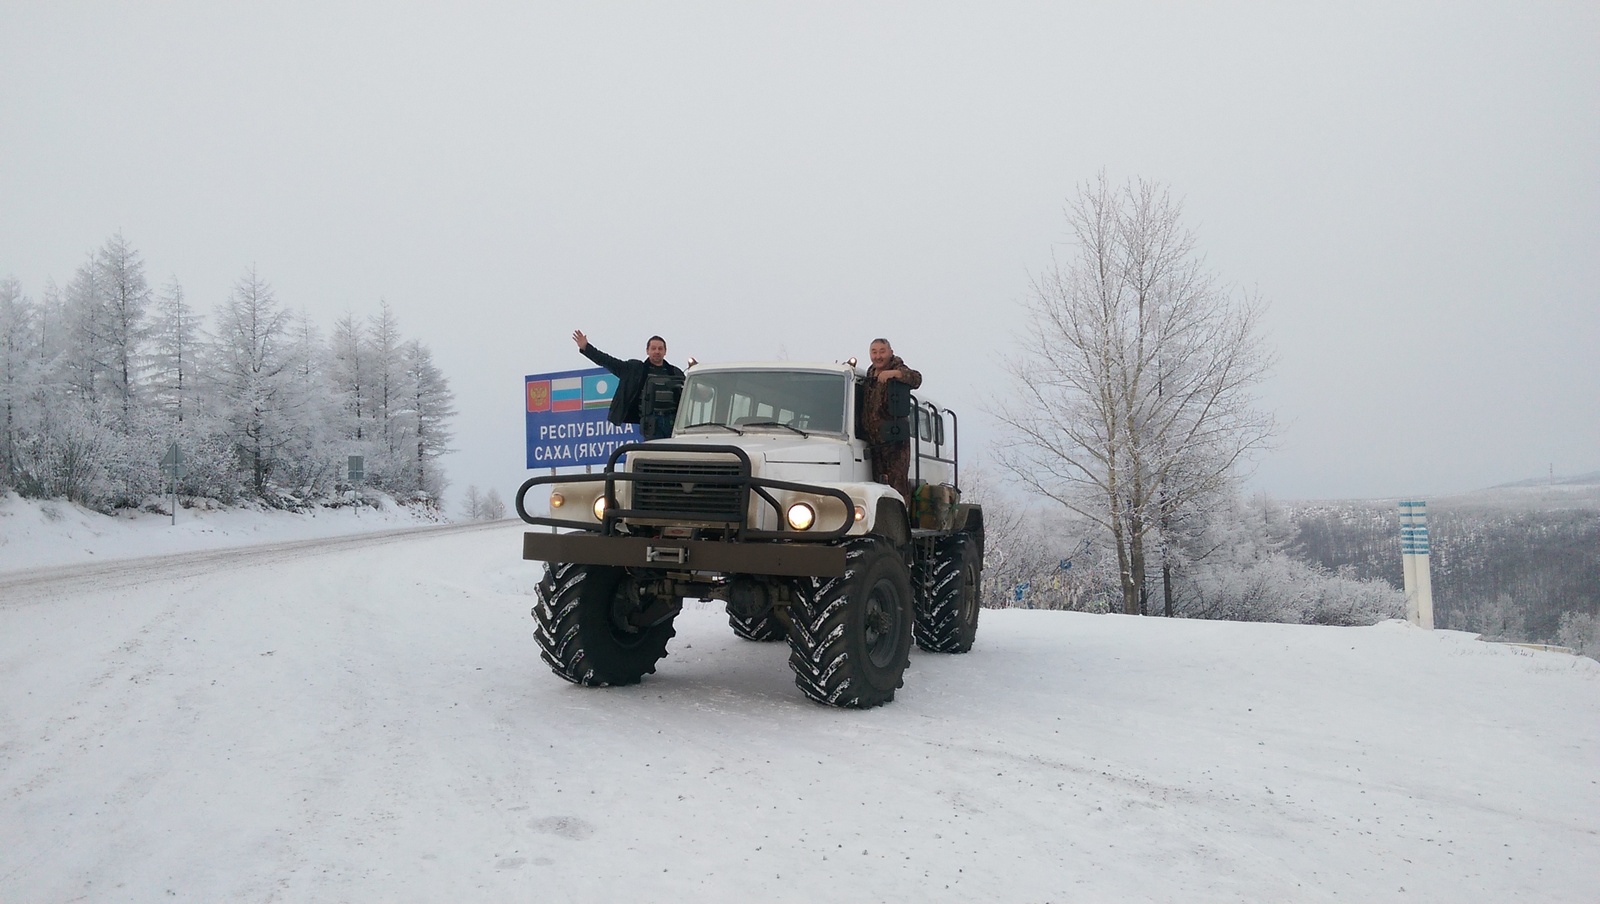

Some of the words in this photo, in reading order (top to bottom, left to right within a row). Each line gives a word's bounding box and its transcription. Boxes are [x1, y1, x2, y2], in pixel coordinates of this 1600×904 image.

[540, 420, 634, 440] РЕСПУБЛИКА
[534, 444, 571, 461] САХА
[574, 439, 639, 462] (ЯКУТ
